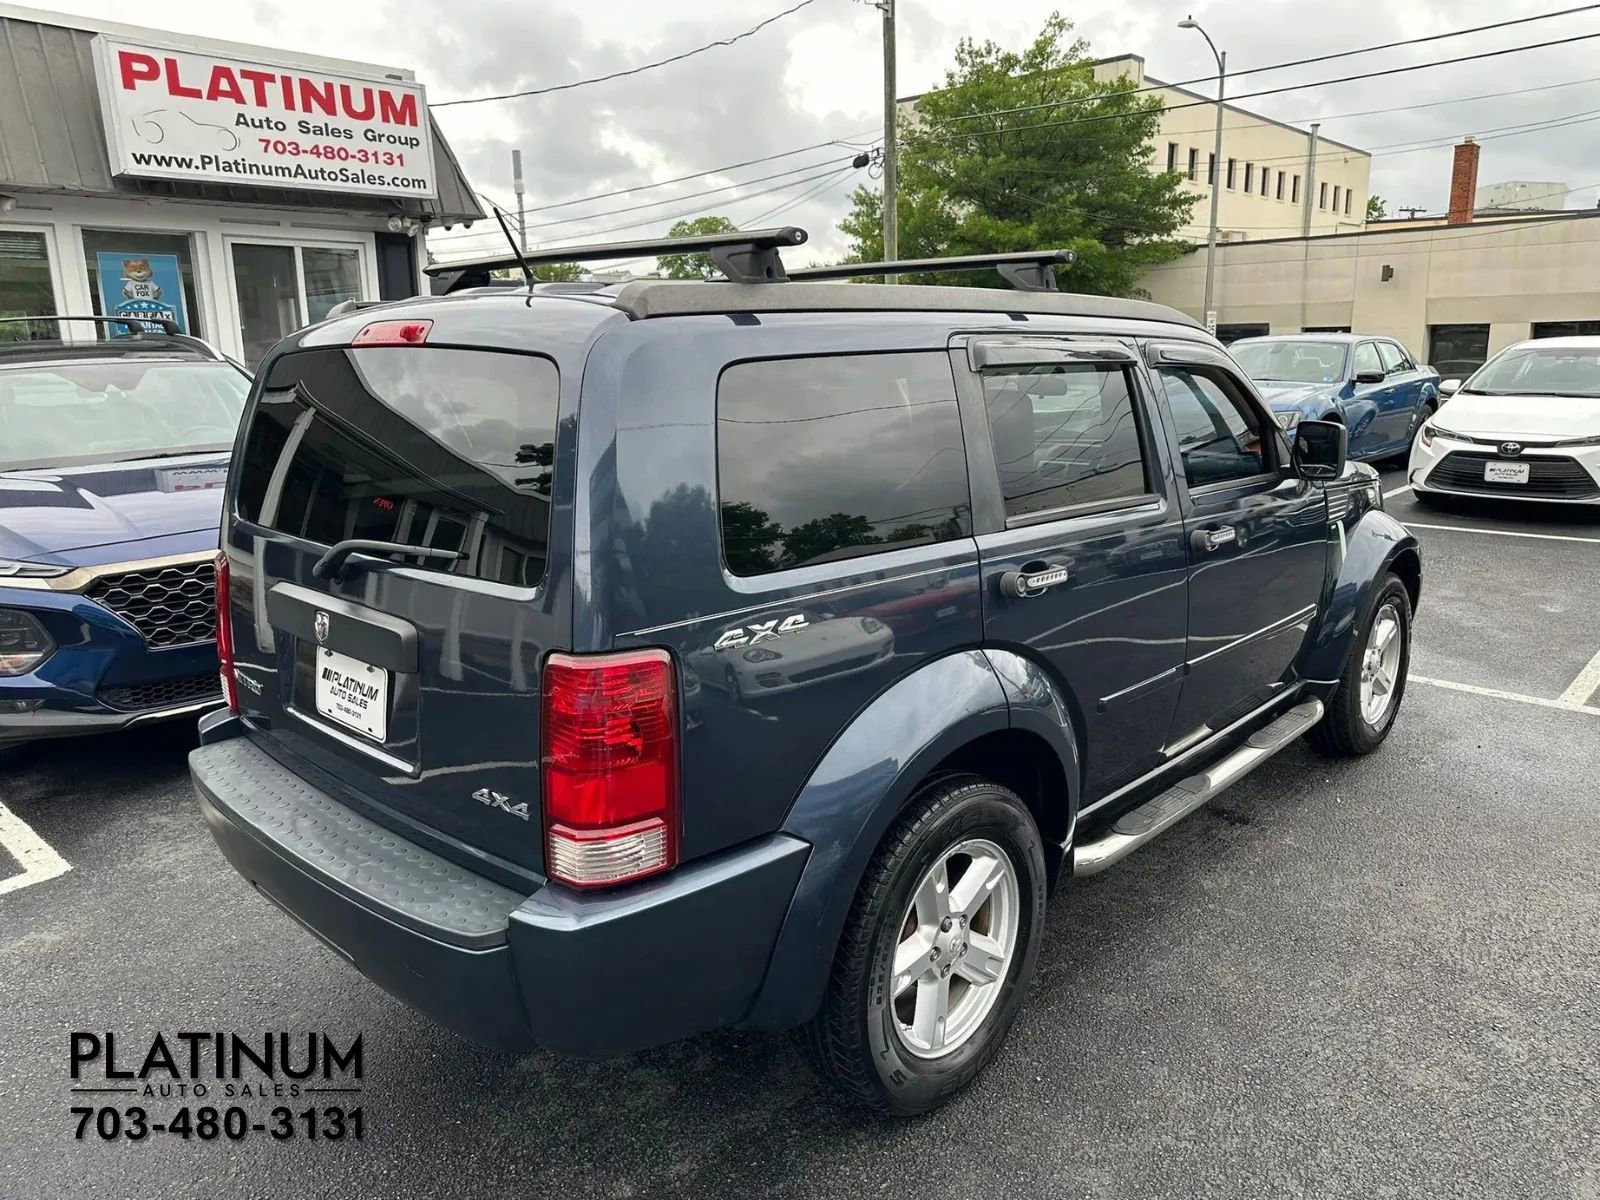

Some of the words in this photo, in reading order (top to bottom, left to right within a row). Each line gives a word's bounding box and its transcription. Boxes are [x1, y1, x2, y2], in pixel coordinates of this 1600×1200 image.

[118, 50, 419, 127] PLATINUM
[235, 112, 287, 132] Auto
[297, 119, 354, 140] Sales
[363, 128, 420, 149] Group
[257, 137, 405, 167] 703-480-3131
[131, 151, 427, 189] www.PlatinumAutoSales.com
[329, 685, 347, 700] AUTO
[347, 693, 369, 710] SALES
[332, 670, 380, 702] PLATINUM
